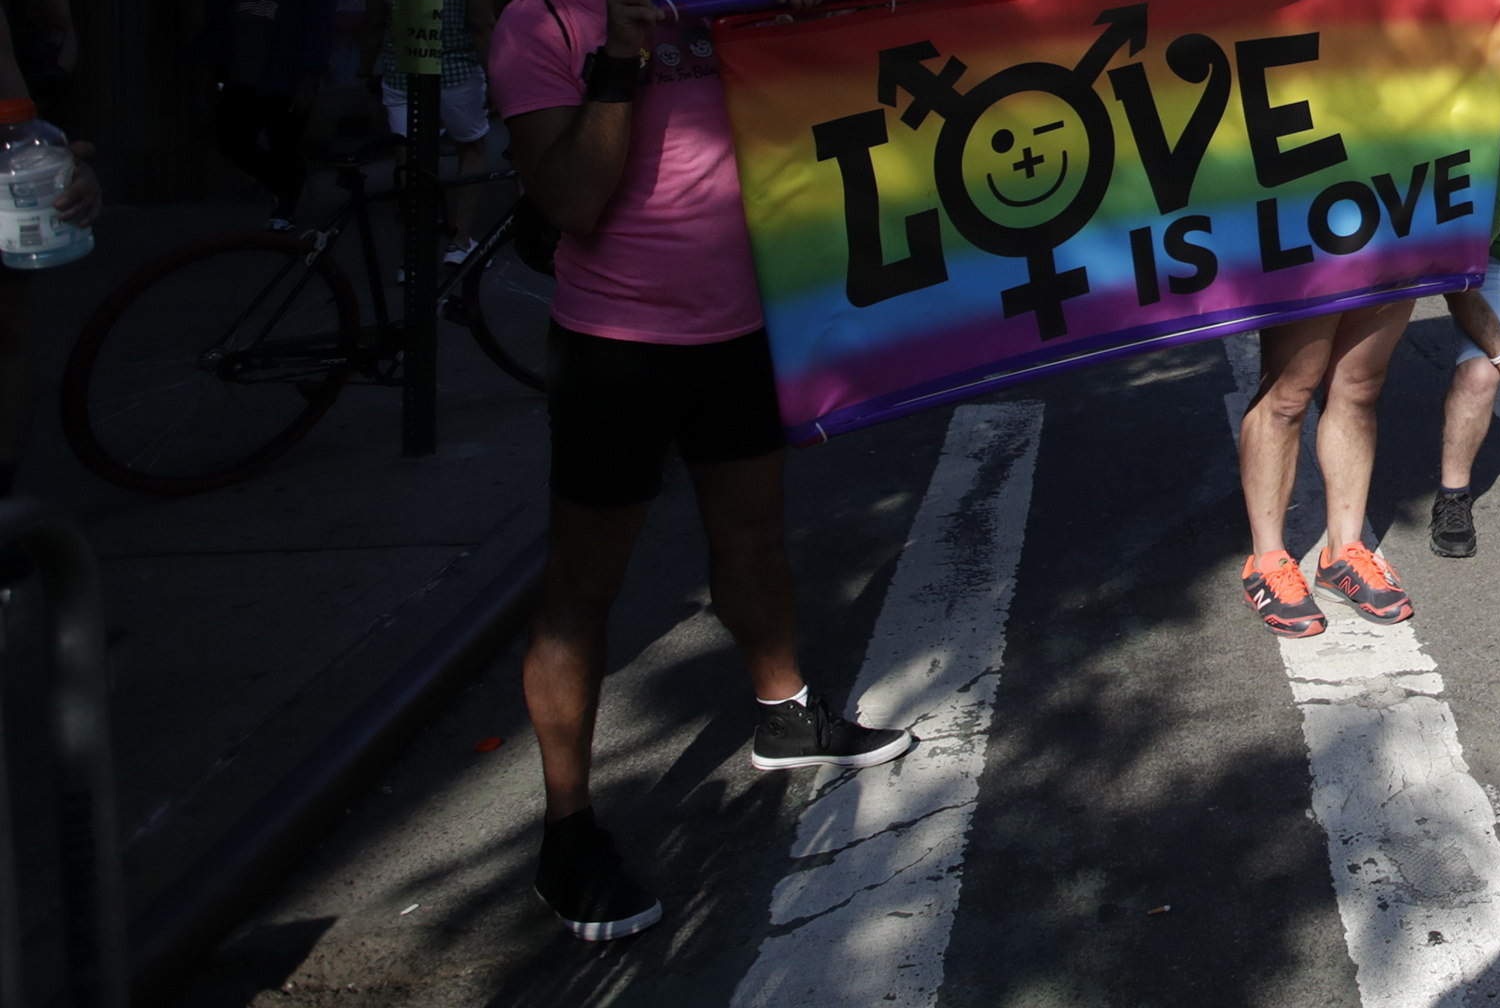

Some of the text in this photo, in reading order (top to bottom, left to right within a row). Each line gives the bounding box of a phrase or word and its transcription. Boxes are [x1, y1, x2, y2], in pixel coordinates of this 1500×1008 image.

[811, 31, 1348, 309] LOVE
[1128, 148, 1475, 307] IS LOVE
